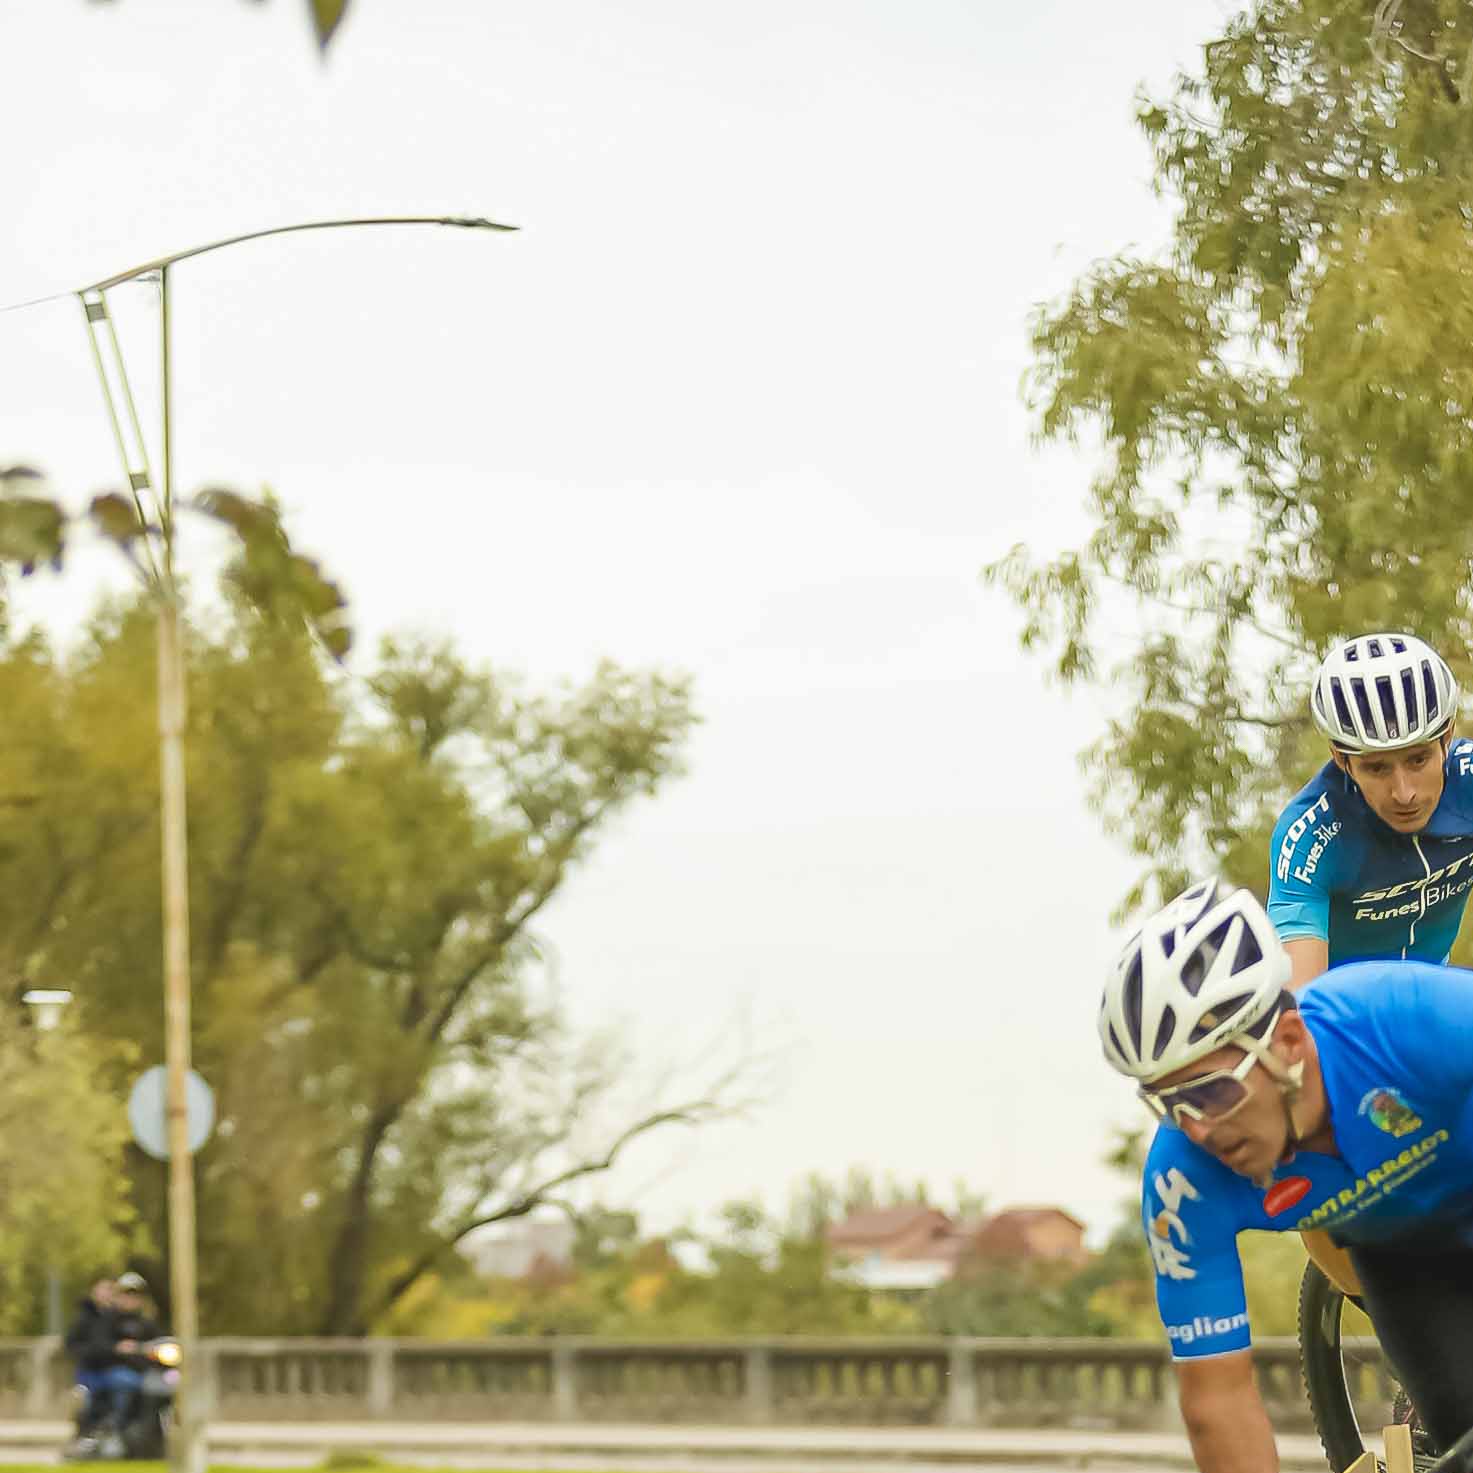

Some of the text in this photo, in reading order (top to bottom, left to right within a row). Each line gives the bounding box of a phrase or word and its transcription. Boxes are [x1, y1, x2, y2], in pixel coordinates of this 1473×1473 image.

[1277, 792, 1330, 884] SCOTT
[1294, 843, 1324, 885] Funes
[1355, 900, 1420, 921] Funes
